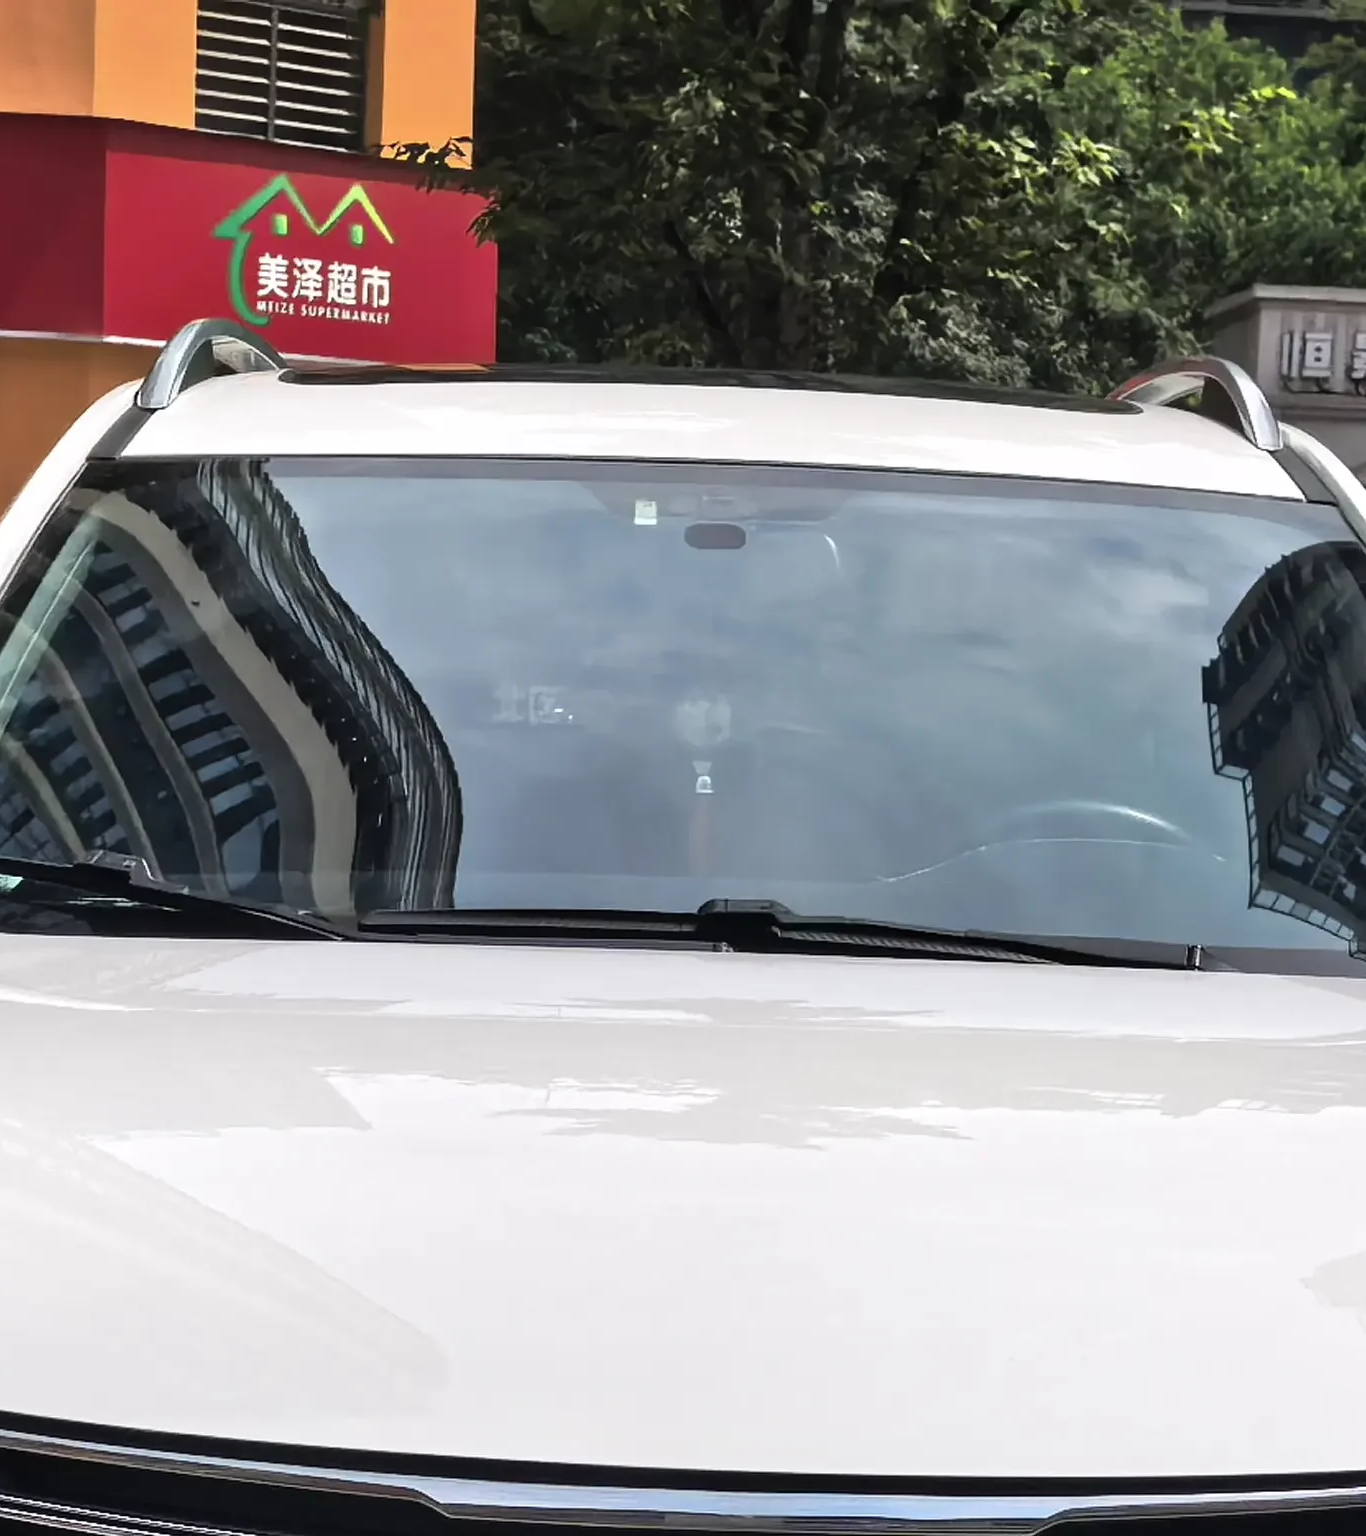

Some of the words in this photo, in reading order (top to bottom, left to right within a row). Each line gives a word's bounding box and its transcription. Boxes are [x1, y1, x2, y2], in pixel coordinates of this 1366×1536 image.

[256, 252, 392, 309] 美泽超市
[257, 300, 295, 315] MEIZE
[300, 304, 390, 324] SUPERMARKET
